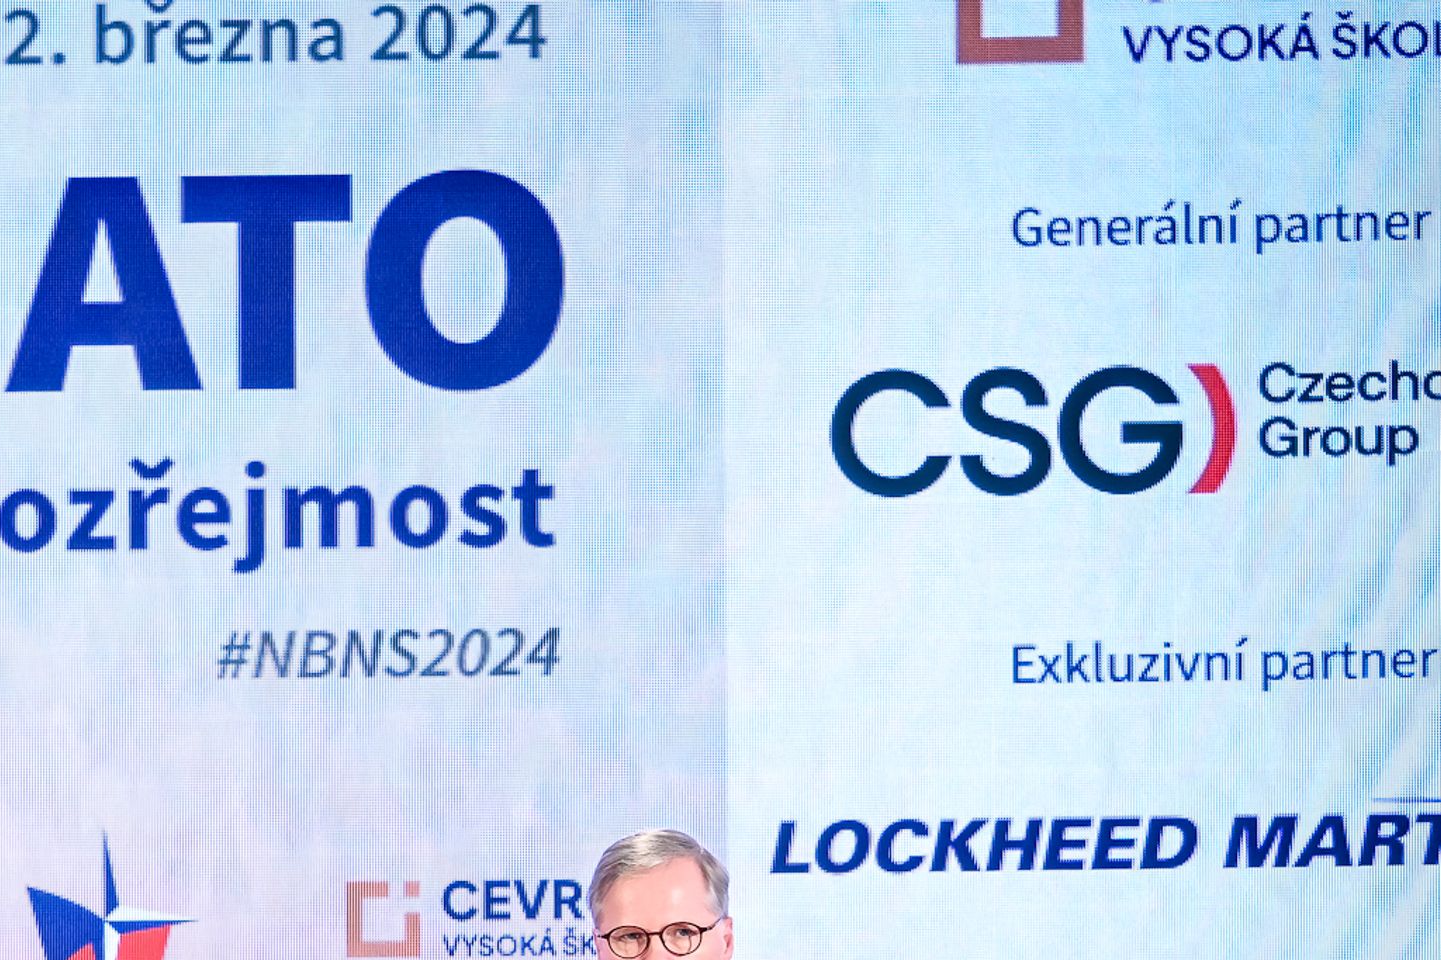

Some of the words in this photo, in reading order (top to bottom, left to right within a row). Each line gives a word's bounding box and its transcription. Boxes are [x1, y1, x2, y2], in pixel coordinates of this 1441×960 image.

[95, 0, 345, 63] března
[371, 4, 546, 61] 2024
[1122, 11, 1320, 63] VYSOKÁ
[1011, 199, 1242, 247] Generální
[1255, 206, 1431, 253] partner
[1259, 416, 1419, 466] Group
[217, 627, 561, 679] #NBNS2024
[1012, 637, 1248, 685] Exkluzivní
[1261, 641, 1439, 691] partner
[770, 817, 1199, 874] LOCKHEED
[441, 879, 584, 921] CEVR
[443, 927, 557, 957] VYSOKÁ
